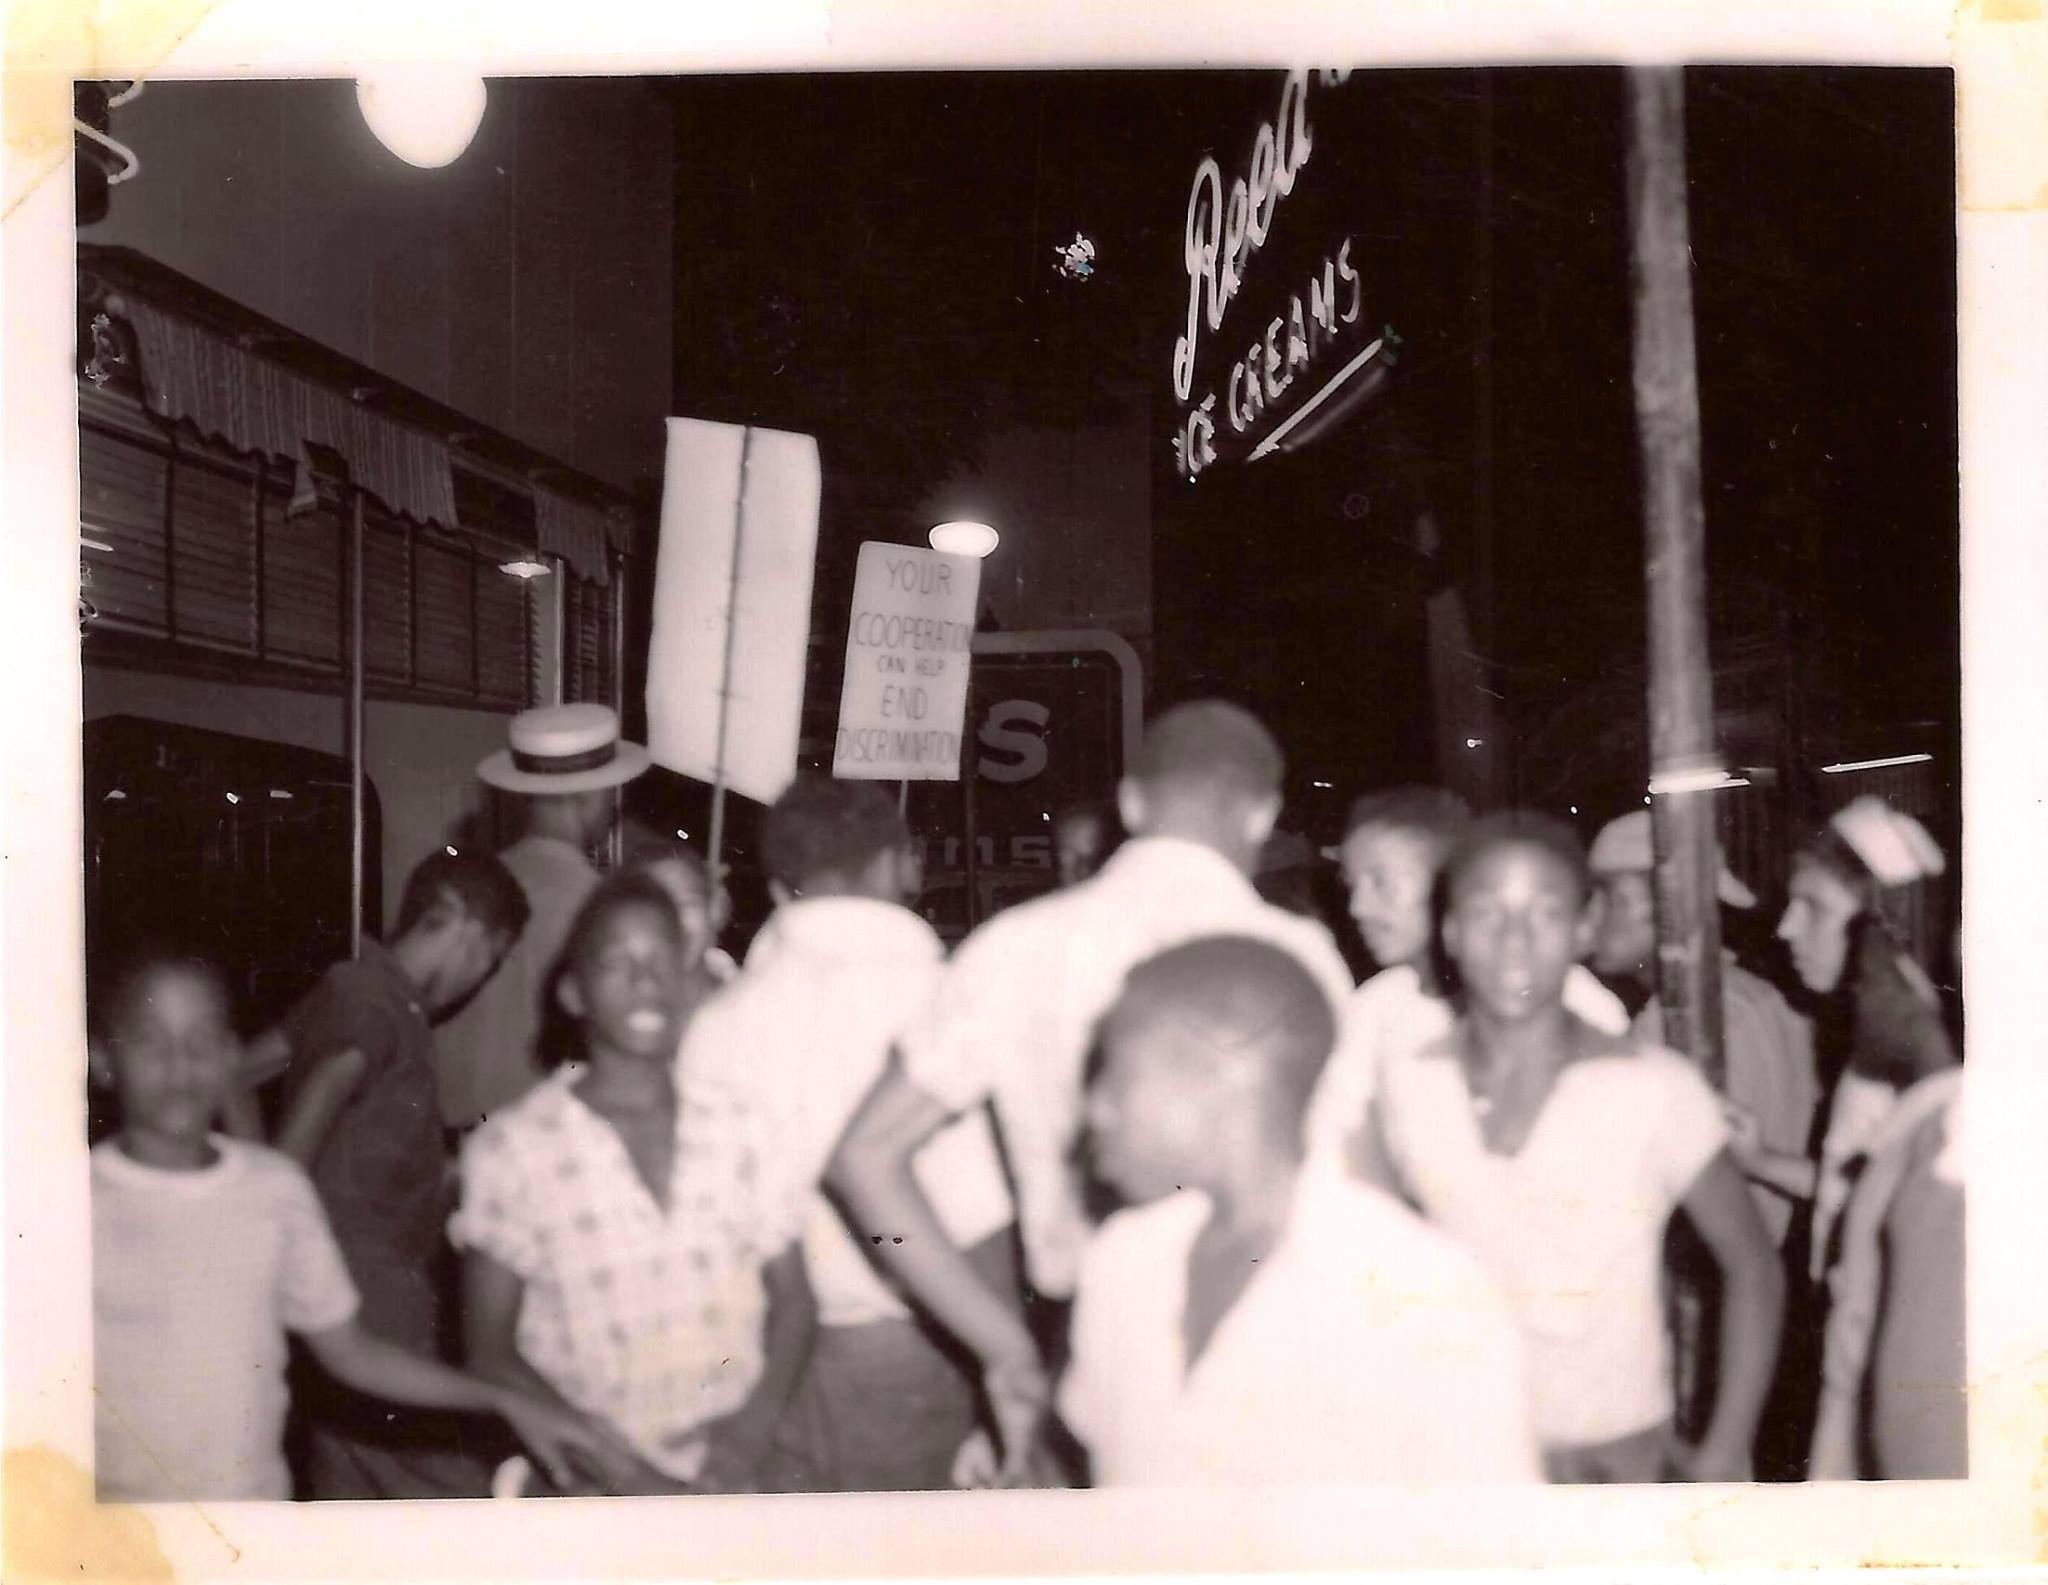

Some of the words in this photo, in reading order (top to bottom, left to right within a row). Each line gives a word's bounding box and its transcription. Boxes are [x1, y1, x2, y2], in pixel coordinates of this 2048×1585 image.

[1173, 68, 1353, 402] Reed
[1228, 236, 1361, 434] CREAMS
[886, 559, 953, 596] YOUR
[876, 654, 905, 675] CAN
[914, 658, 946, 677] HELP
[880, 685, 928, 721] END
[836, 726, 959, 765] DISCRIMINATION
